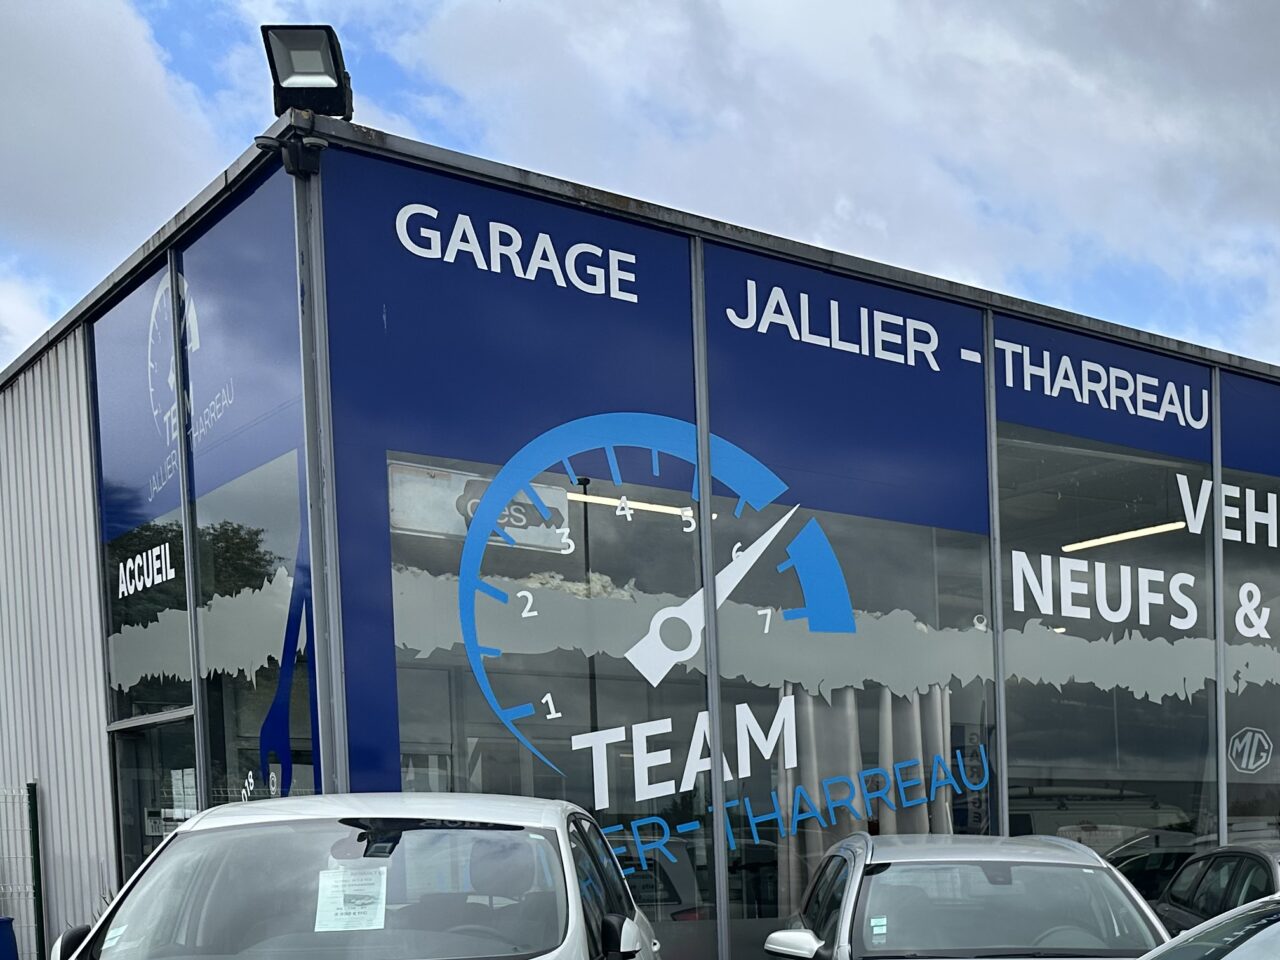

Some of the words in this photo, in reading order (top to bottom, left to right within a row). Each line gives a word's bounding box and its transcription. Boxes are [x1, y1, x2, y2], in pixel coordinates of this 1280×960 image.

[395, 203, 638, 303] GARAGE
[726, 279, 940, 372] JALLIER
[994, 339, 1209, 430] THARREAU
[163, 381, 196, 447] TEM
[615, 496, 634, 521] 4
[681, 507, 697, 533] 5
[556, 527, 575, 555] 3
[118, 542, 175, 599] ACCUEIL
[516, 590, 538, 618] 2
[1011, 550, 1198, 630] NEUFS
[1235, 581, 1271, 639] &
[757, 608, 771, 634] 7
[540, 693, 562, 720] 1
[571, 695, 798, 811] TEAM
[1231, 731, 1269, 770] MG
